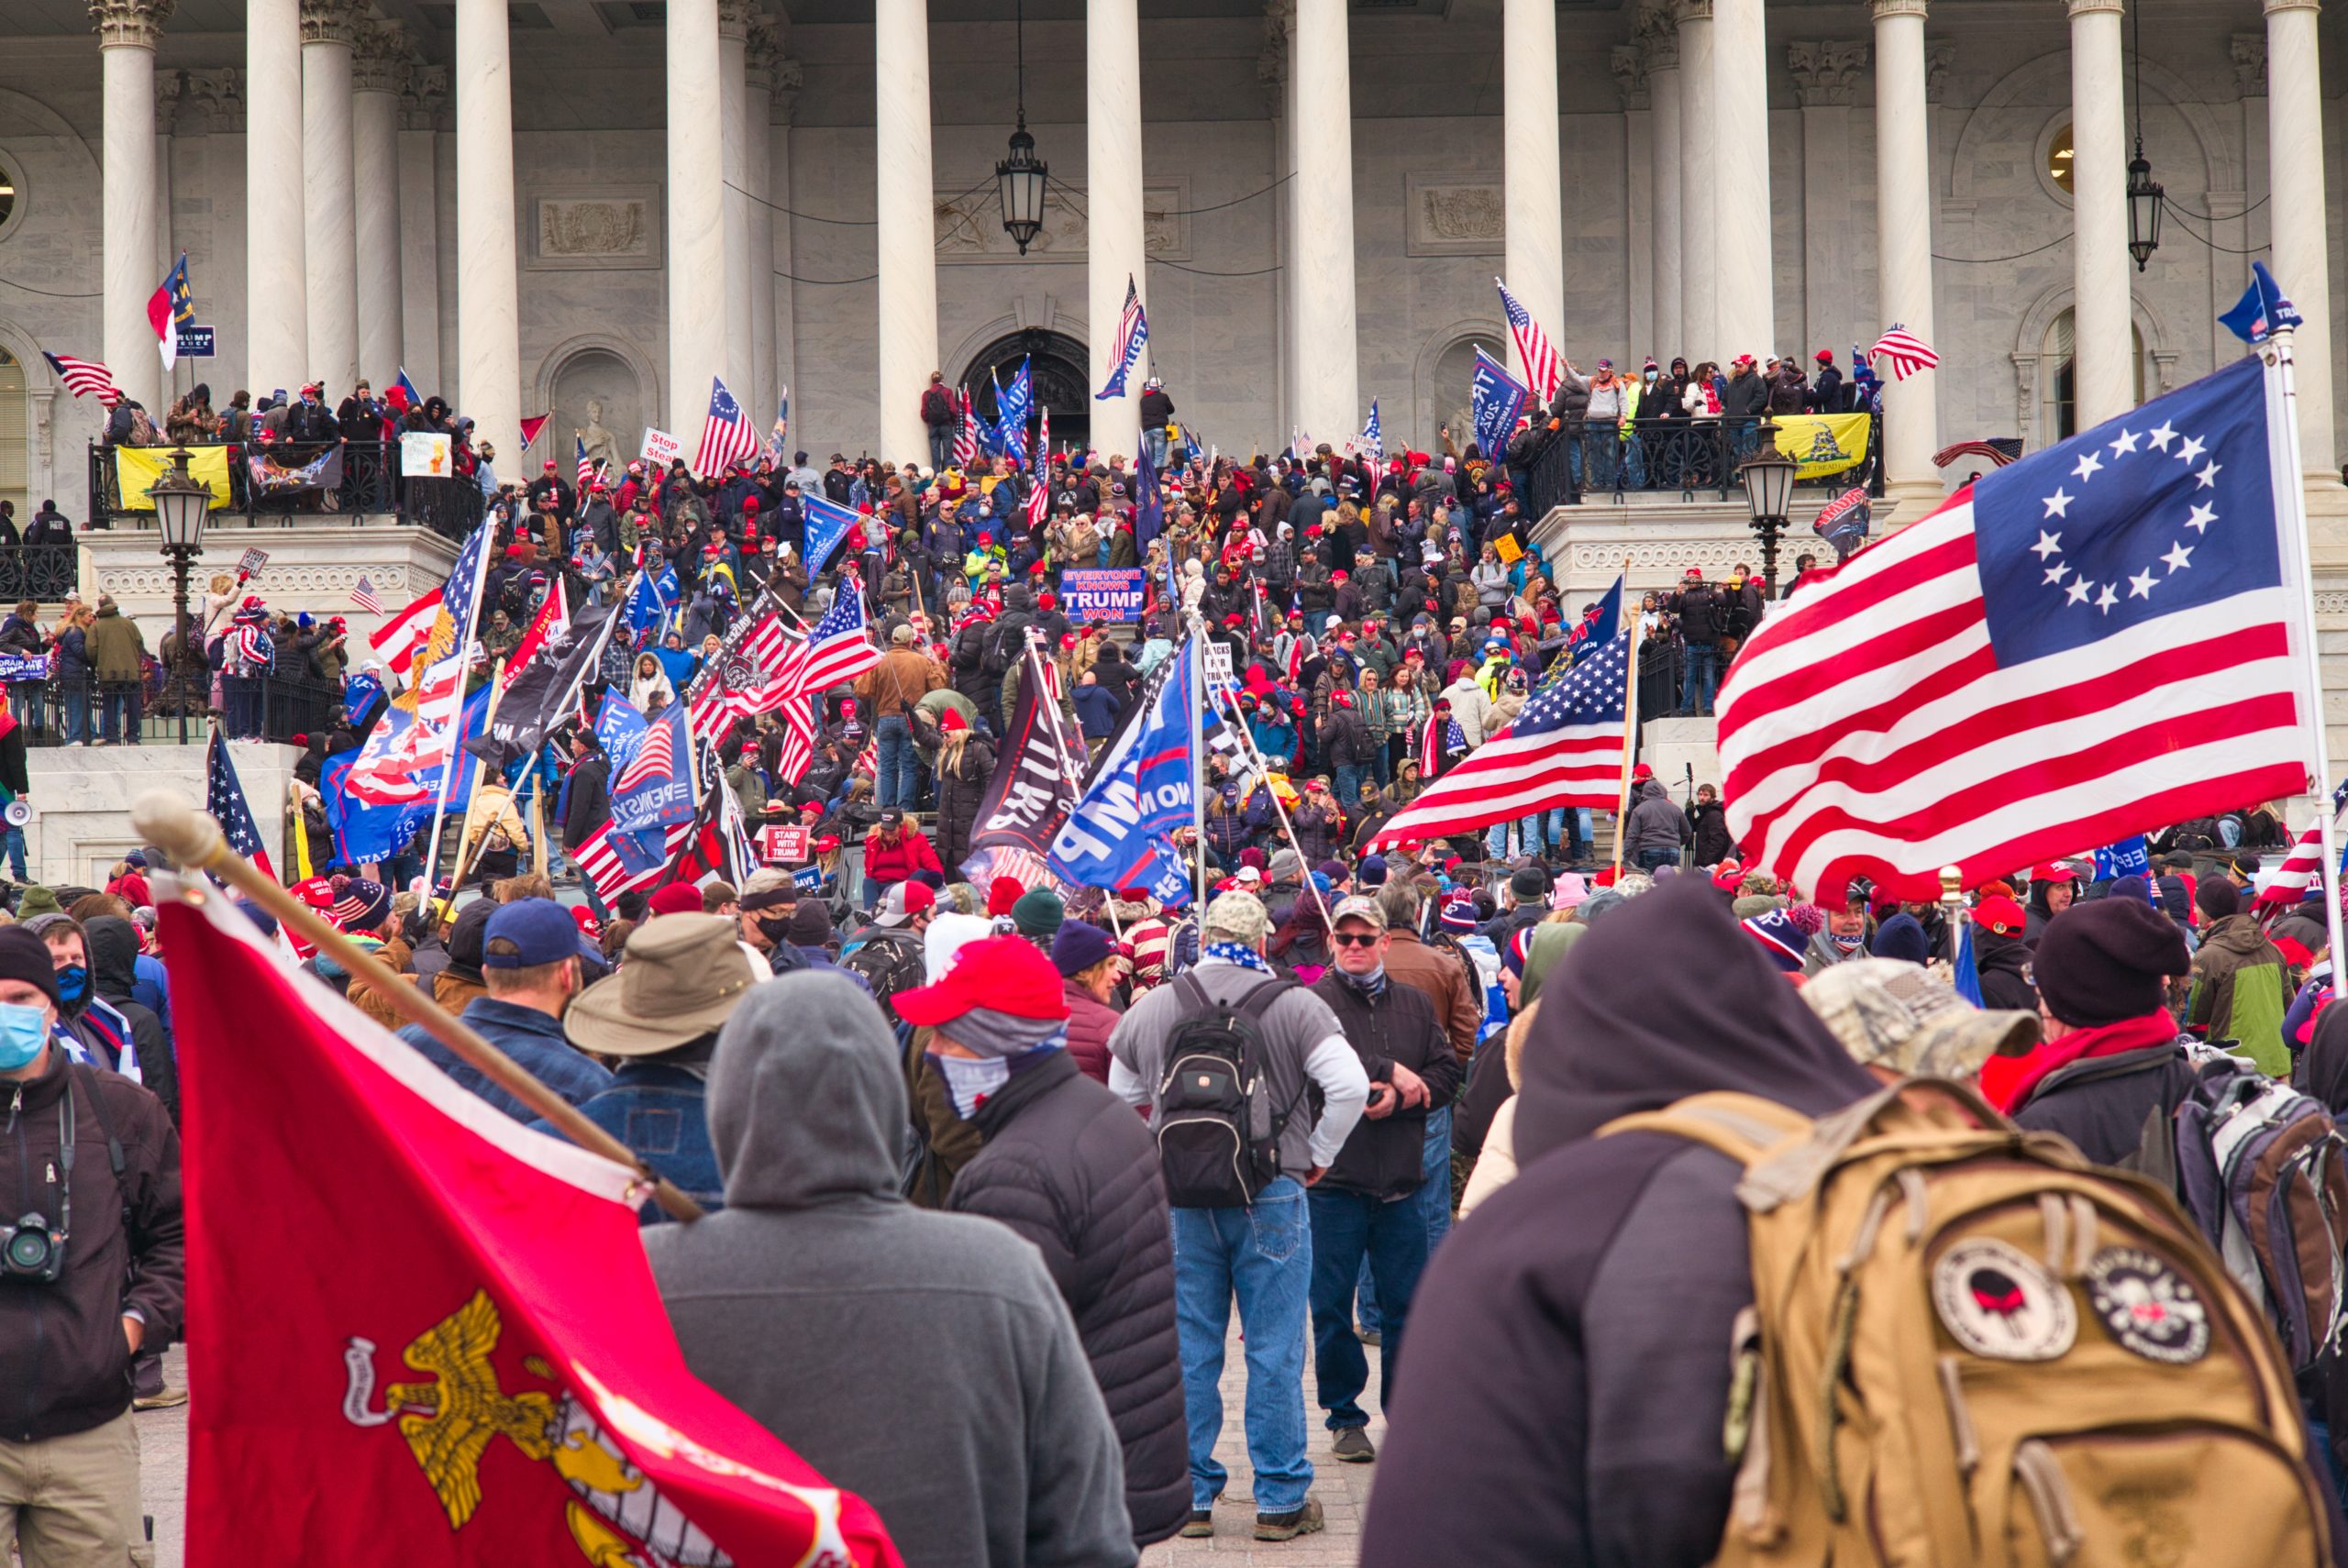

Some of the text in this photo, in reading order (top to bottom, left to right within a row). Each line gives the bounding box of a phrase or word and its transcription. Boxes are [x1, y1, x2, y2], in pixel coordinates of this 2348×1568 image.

[650, 433, 678, 451] Stop
[1813, 463, 1837, 471] TREAD
[246, 550, 264, 562] STOP
[1064, 570, 1142, 580] EVERYONE
[1076, 581, 1131, 591] KNOWS
[1062, 591, 1144, 608] TRUMP
[1082, 608, 1124, 620] WON
[1204, 646, 1230, 656] BACKS
[0, 658, 24, 667] DRAIN
[1211, 658, 1225, 668] FR
[773, 831, 801, 839] STAND
[776, 839, 797, 848] WITH
[772, 848, 800, 857] TRUMP
[794, 876, 814, 889] SAVE
